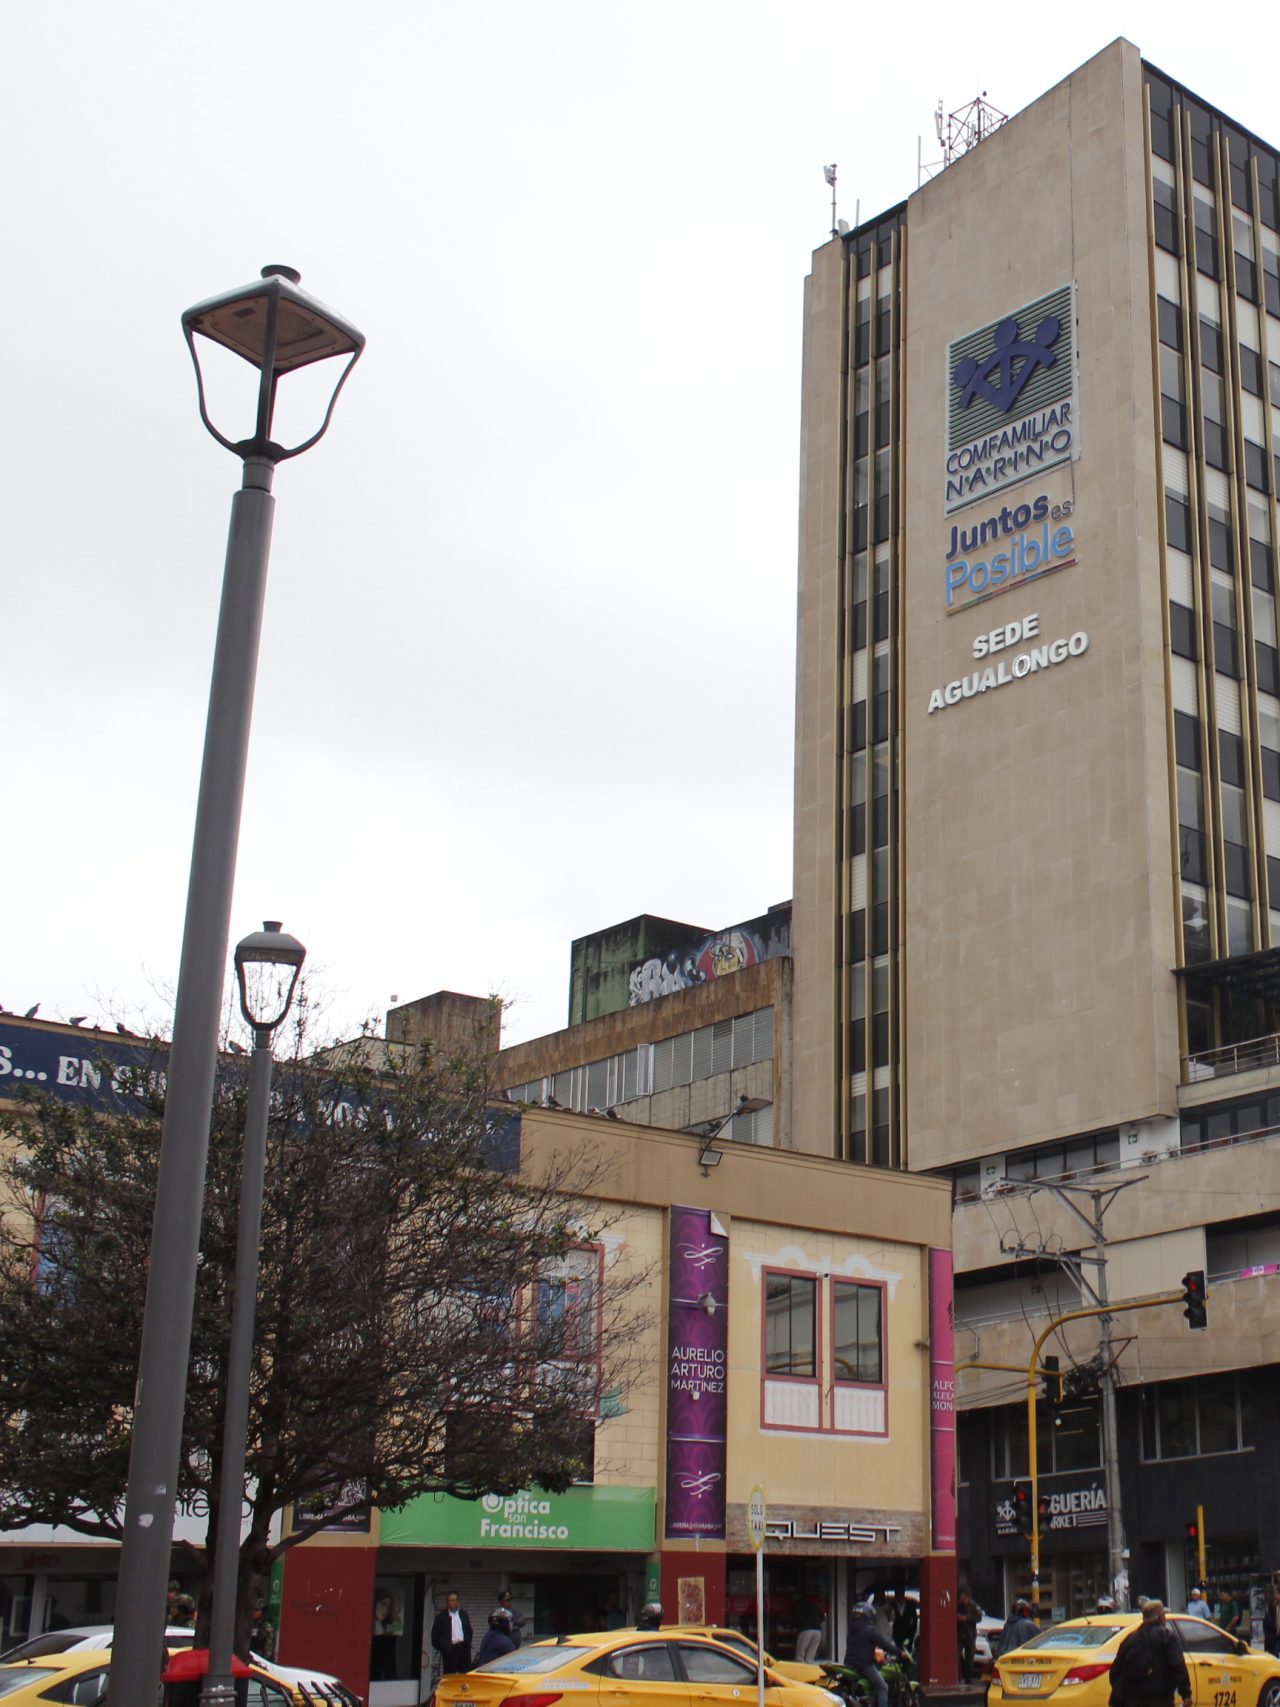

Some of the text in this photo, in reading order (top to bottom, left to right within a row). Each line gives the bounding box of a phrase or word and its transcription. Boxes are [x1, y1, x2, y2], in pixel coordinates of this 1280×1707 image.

[946, 402, 1073, 474] COMFAMILIAR
[945, 493, 1072, 560] Juntos es
[945, 523, 1075, 605] Posible
[972, 613, 1041, 659] SEDE
[927, 631, 1091, 715] AGUALONGO
[671, 1346, 725, 1363] AURELIO
[671, 1362, 725, 1380] ARTURO
[671, 1378, 725, 1393] MARTÍNEZ
[1048, 1482, 1107, 1514] GUERÍA
[509, 1513, 527, 1524] san
[751, 1503, 763, 1516] SOLO
[480, 1519, 569, 1539] Francisco
[1213, 1690, 1237, 1707] 1724
